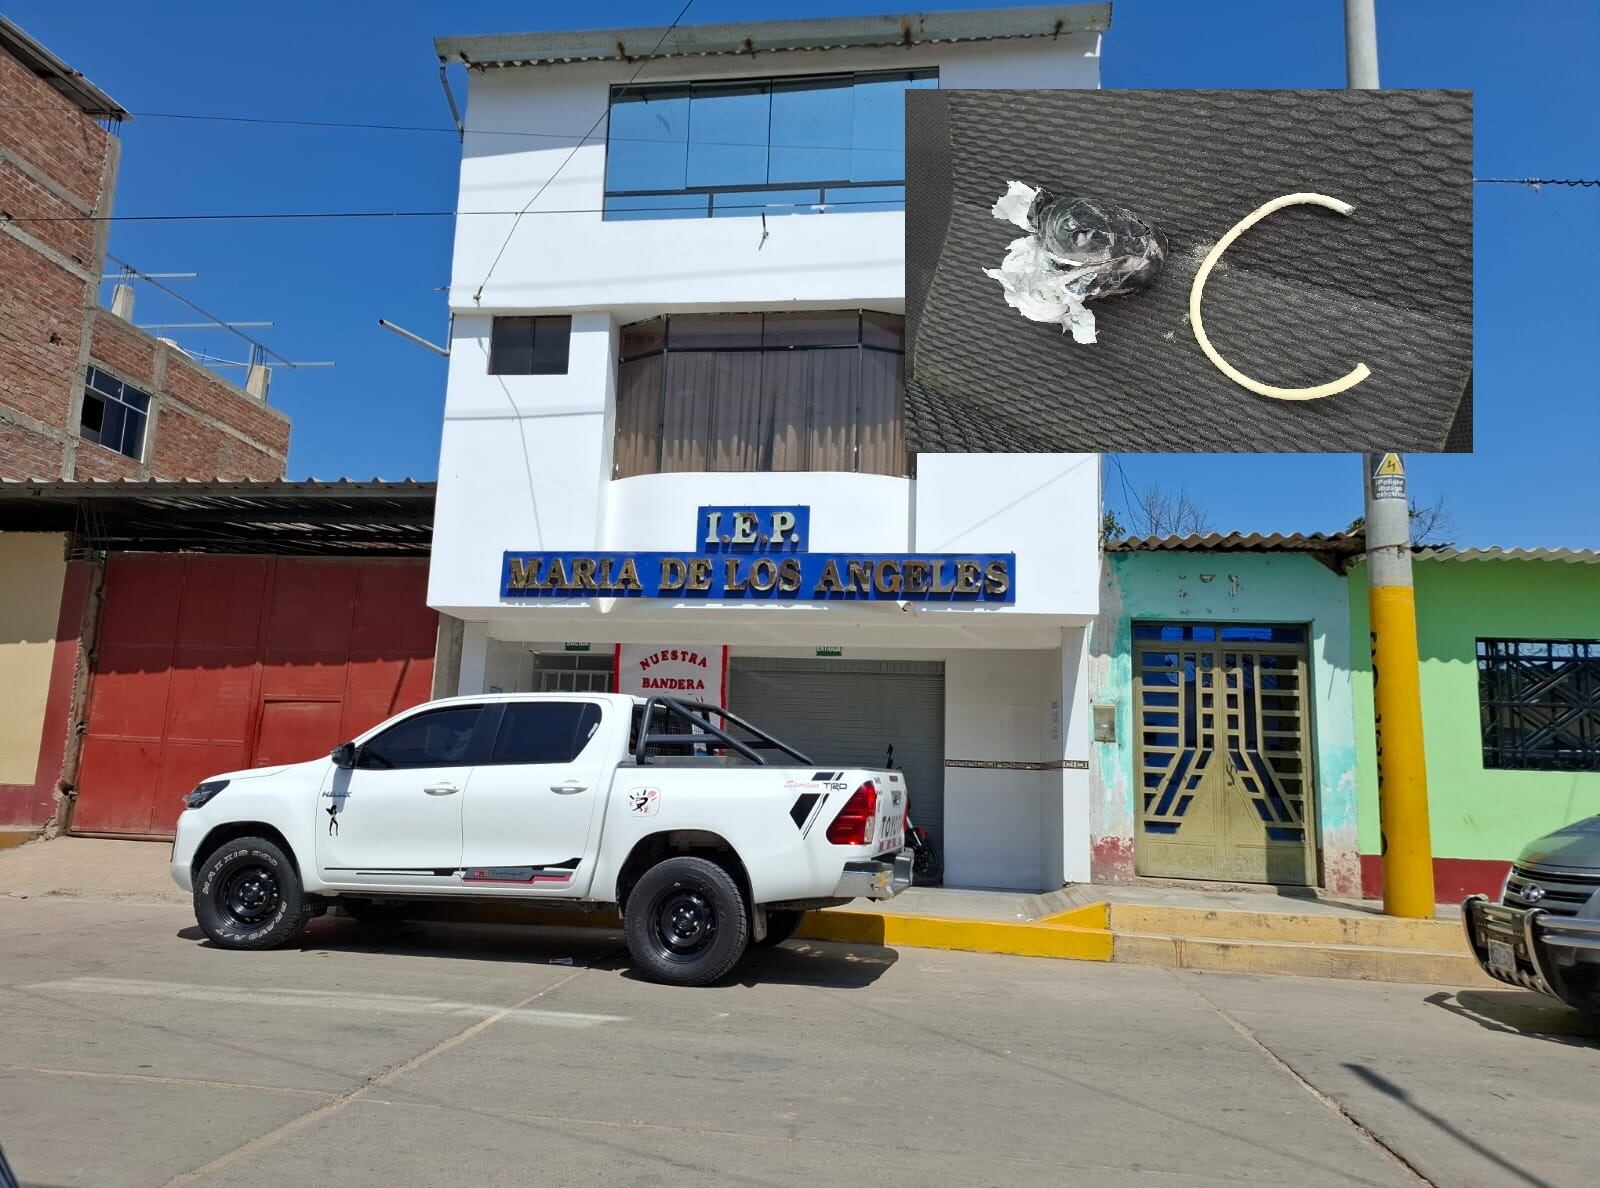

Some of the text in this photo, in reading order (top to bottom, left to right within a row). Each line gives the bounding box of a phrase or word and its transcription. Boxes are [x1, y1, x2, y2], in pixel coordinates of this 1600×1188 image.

[706, 512, 799, 544] I.E.P.
[507, 557, 1009, 593] MARIA DE LOS ANGELES
[639, 650, 708, 671] NUESTRA
[642, 677, 706, 690] BANDERA
[823, 782, 848, 791] TRD
